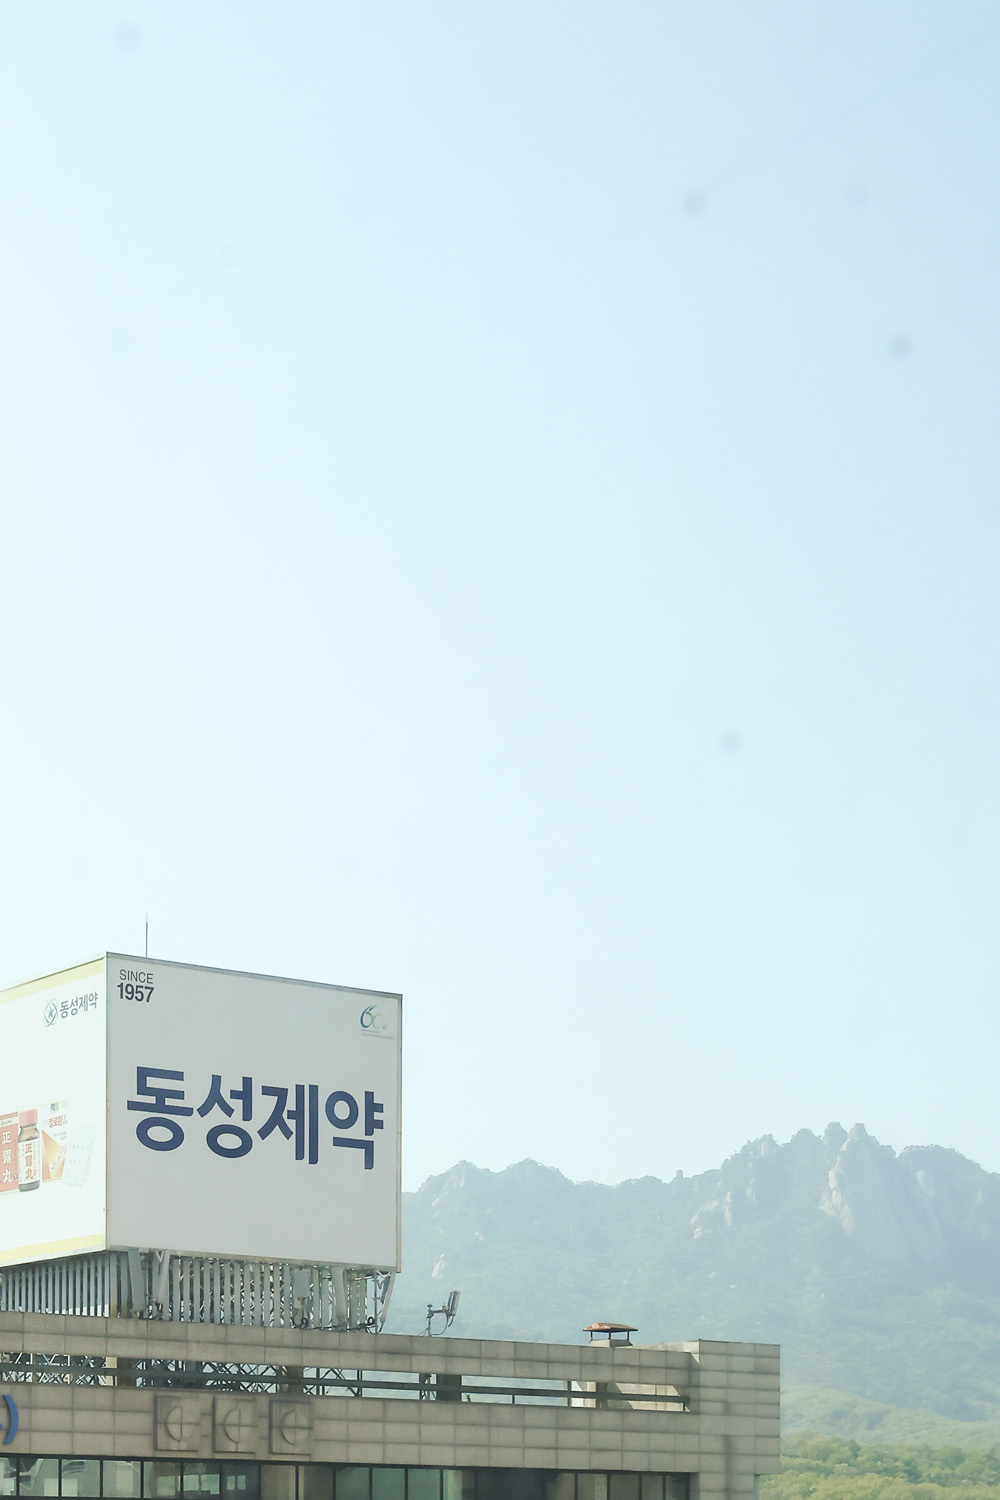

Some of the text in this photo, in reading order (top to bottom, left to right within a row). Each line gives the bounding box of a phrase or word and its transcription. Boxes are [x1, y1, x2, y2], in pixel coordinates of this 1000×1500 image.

[119, 969, 154, 985] SINCE
[116, 982, 154, 1003] 1957
[59, 991, 98, 1019] 동성제약
[126, 1065, 384, 1170] 동성제약
